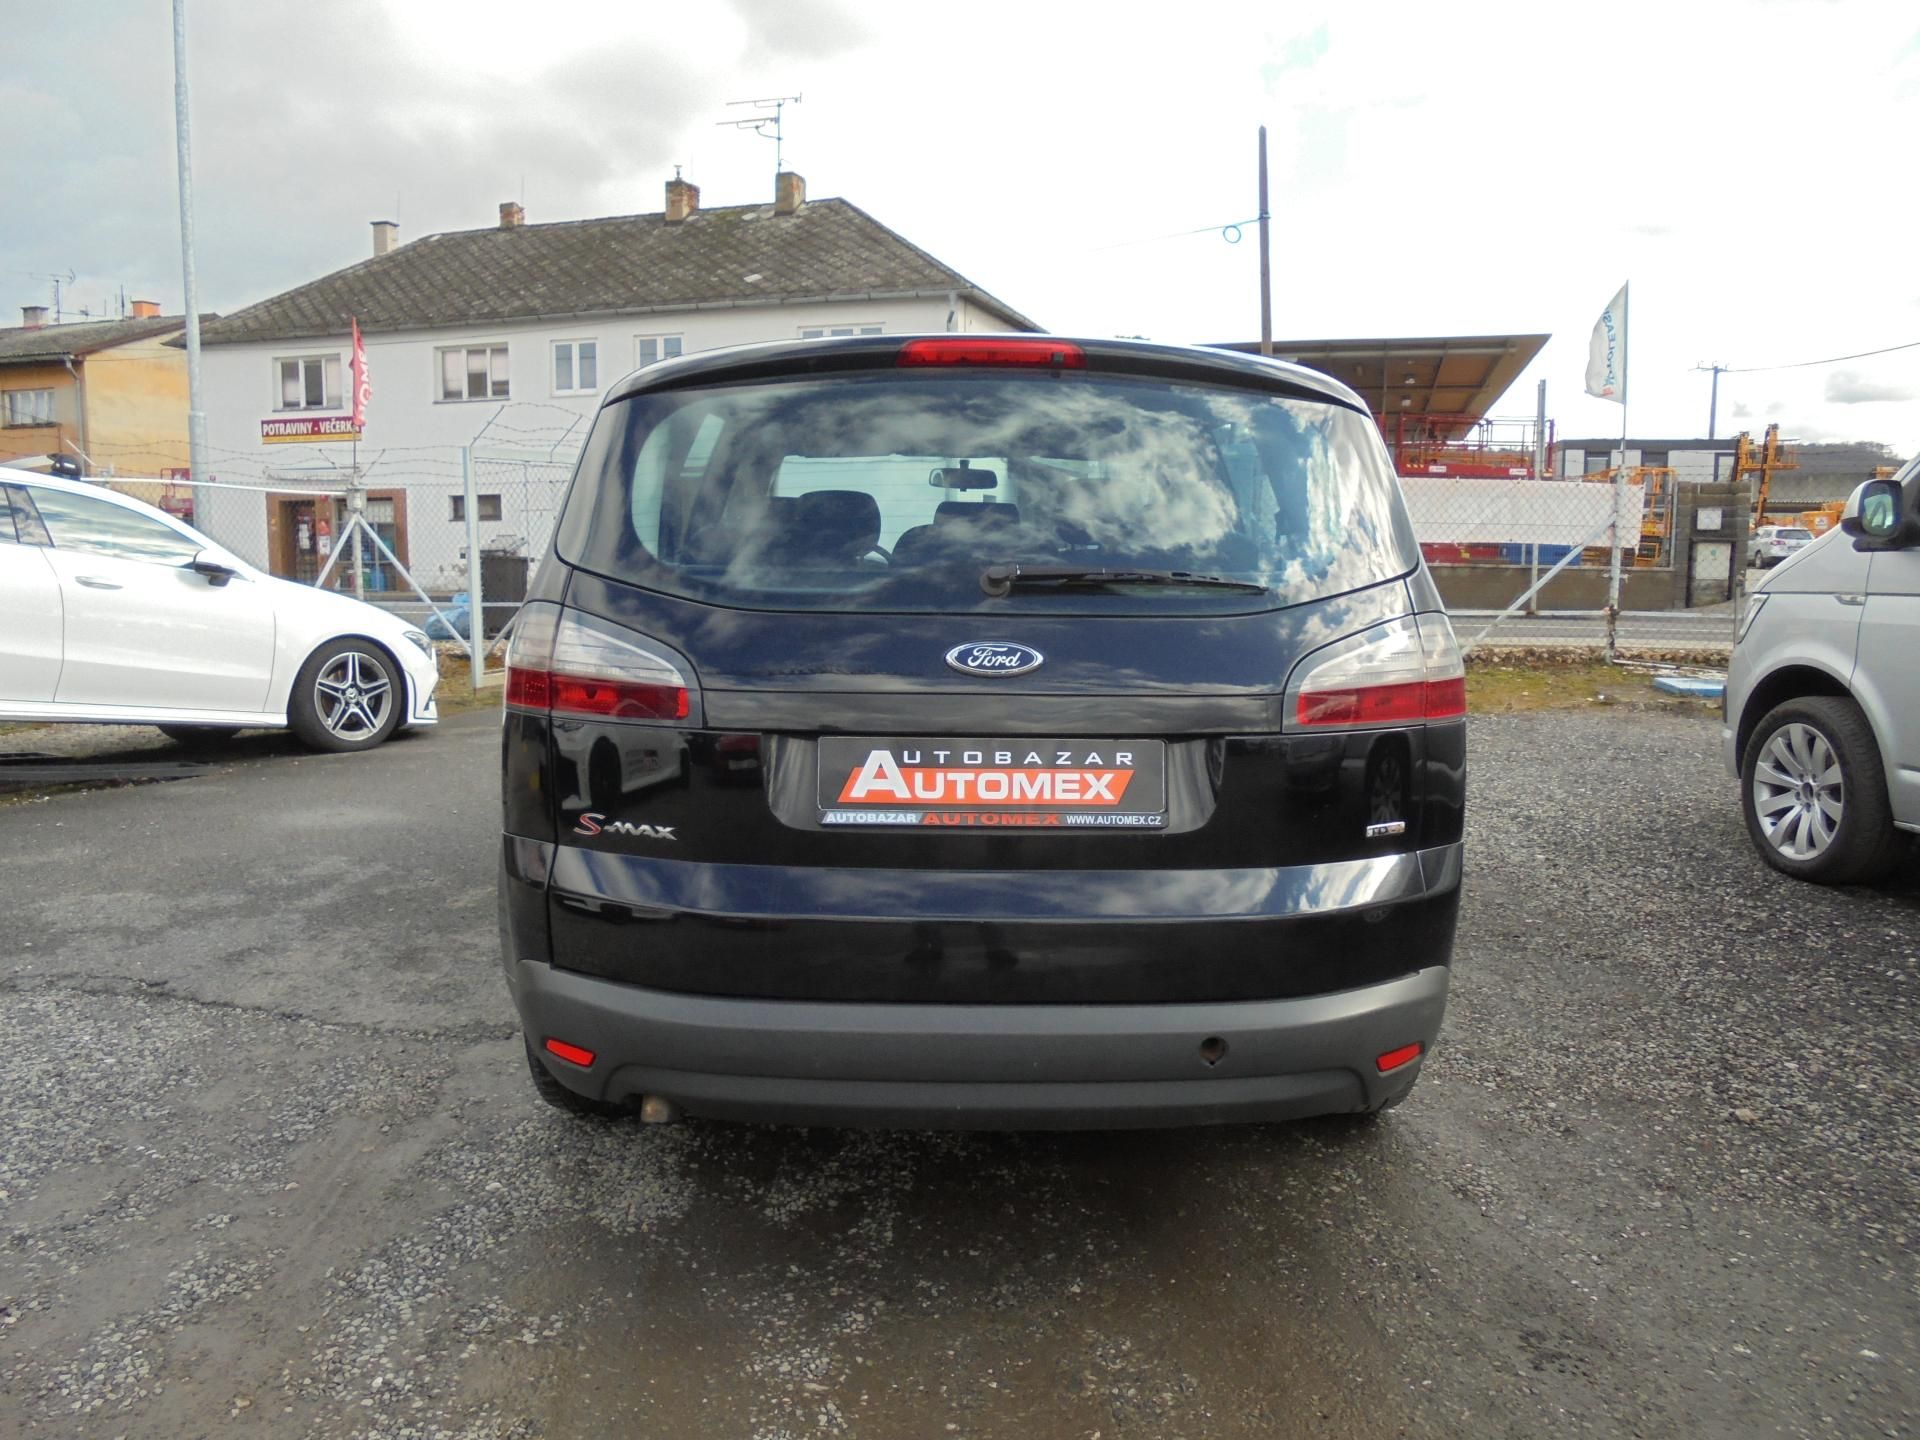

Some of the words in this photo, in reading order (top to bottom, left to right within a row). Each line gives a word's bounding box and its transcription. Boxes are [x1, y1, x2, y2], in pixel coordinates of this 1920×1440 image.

[262, 422, 313, 435] POTRAVINY
[967, 647, 1021, 667] Ford
[850, 750, 1115, 799] AUTOMEX
[826, 813, 917, 824] AUTOBAZAR
[923, 812, 1060, 825] AUTOMEX
[1066, 815, 1162, 825] WWW.AUTOMEX.CZ
